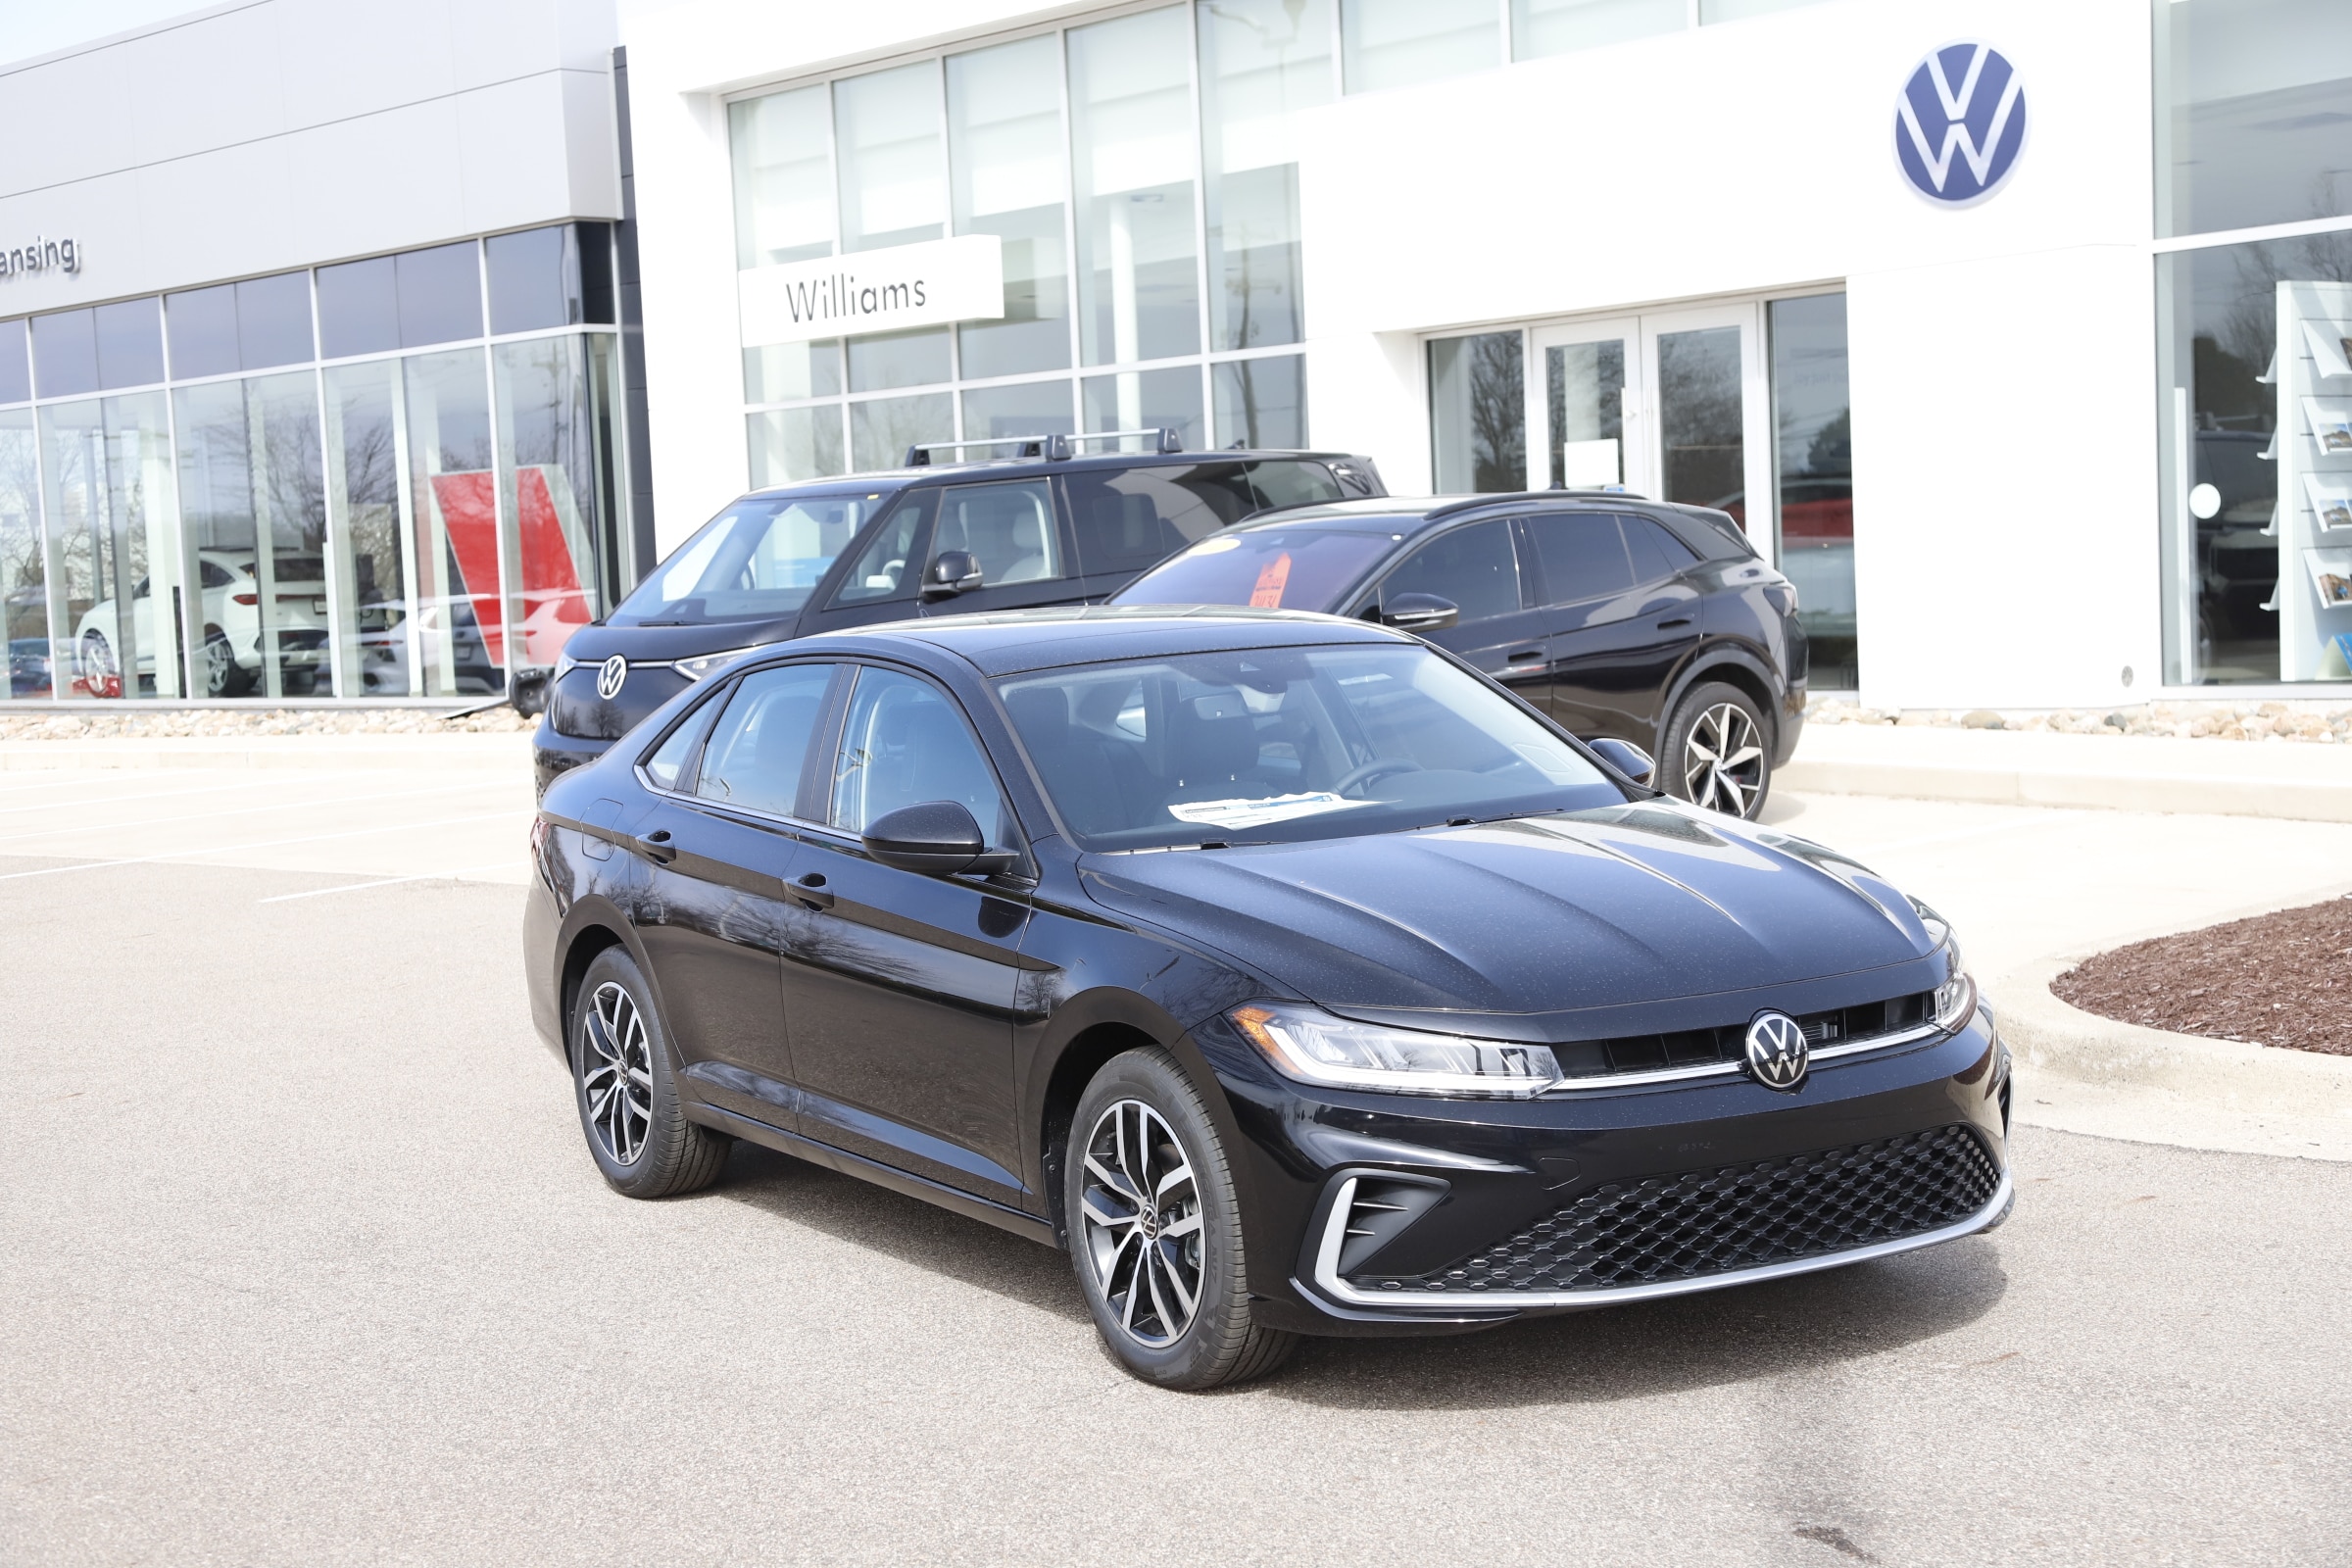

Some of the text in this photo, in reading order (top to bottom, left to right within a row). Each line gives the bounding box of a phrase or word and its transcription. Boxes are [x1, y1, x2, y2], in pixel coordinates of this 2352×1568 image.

[1894, 40, 2028, 203] VW
[0, 234, 76, 275] ansing
[785, 272, 926, 323] Williams
[599, 656, 625, 698] VW
[1748, 1015, 1806, 1086] VW
